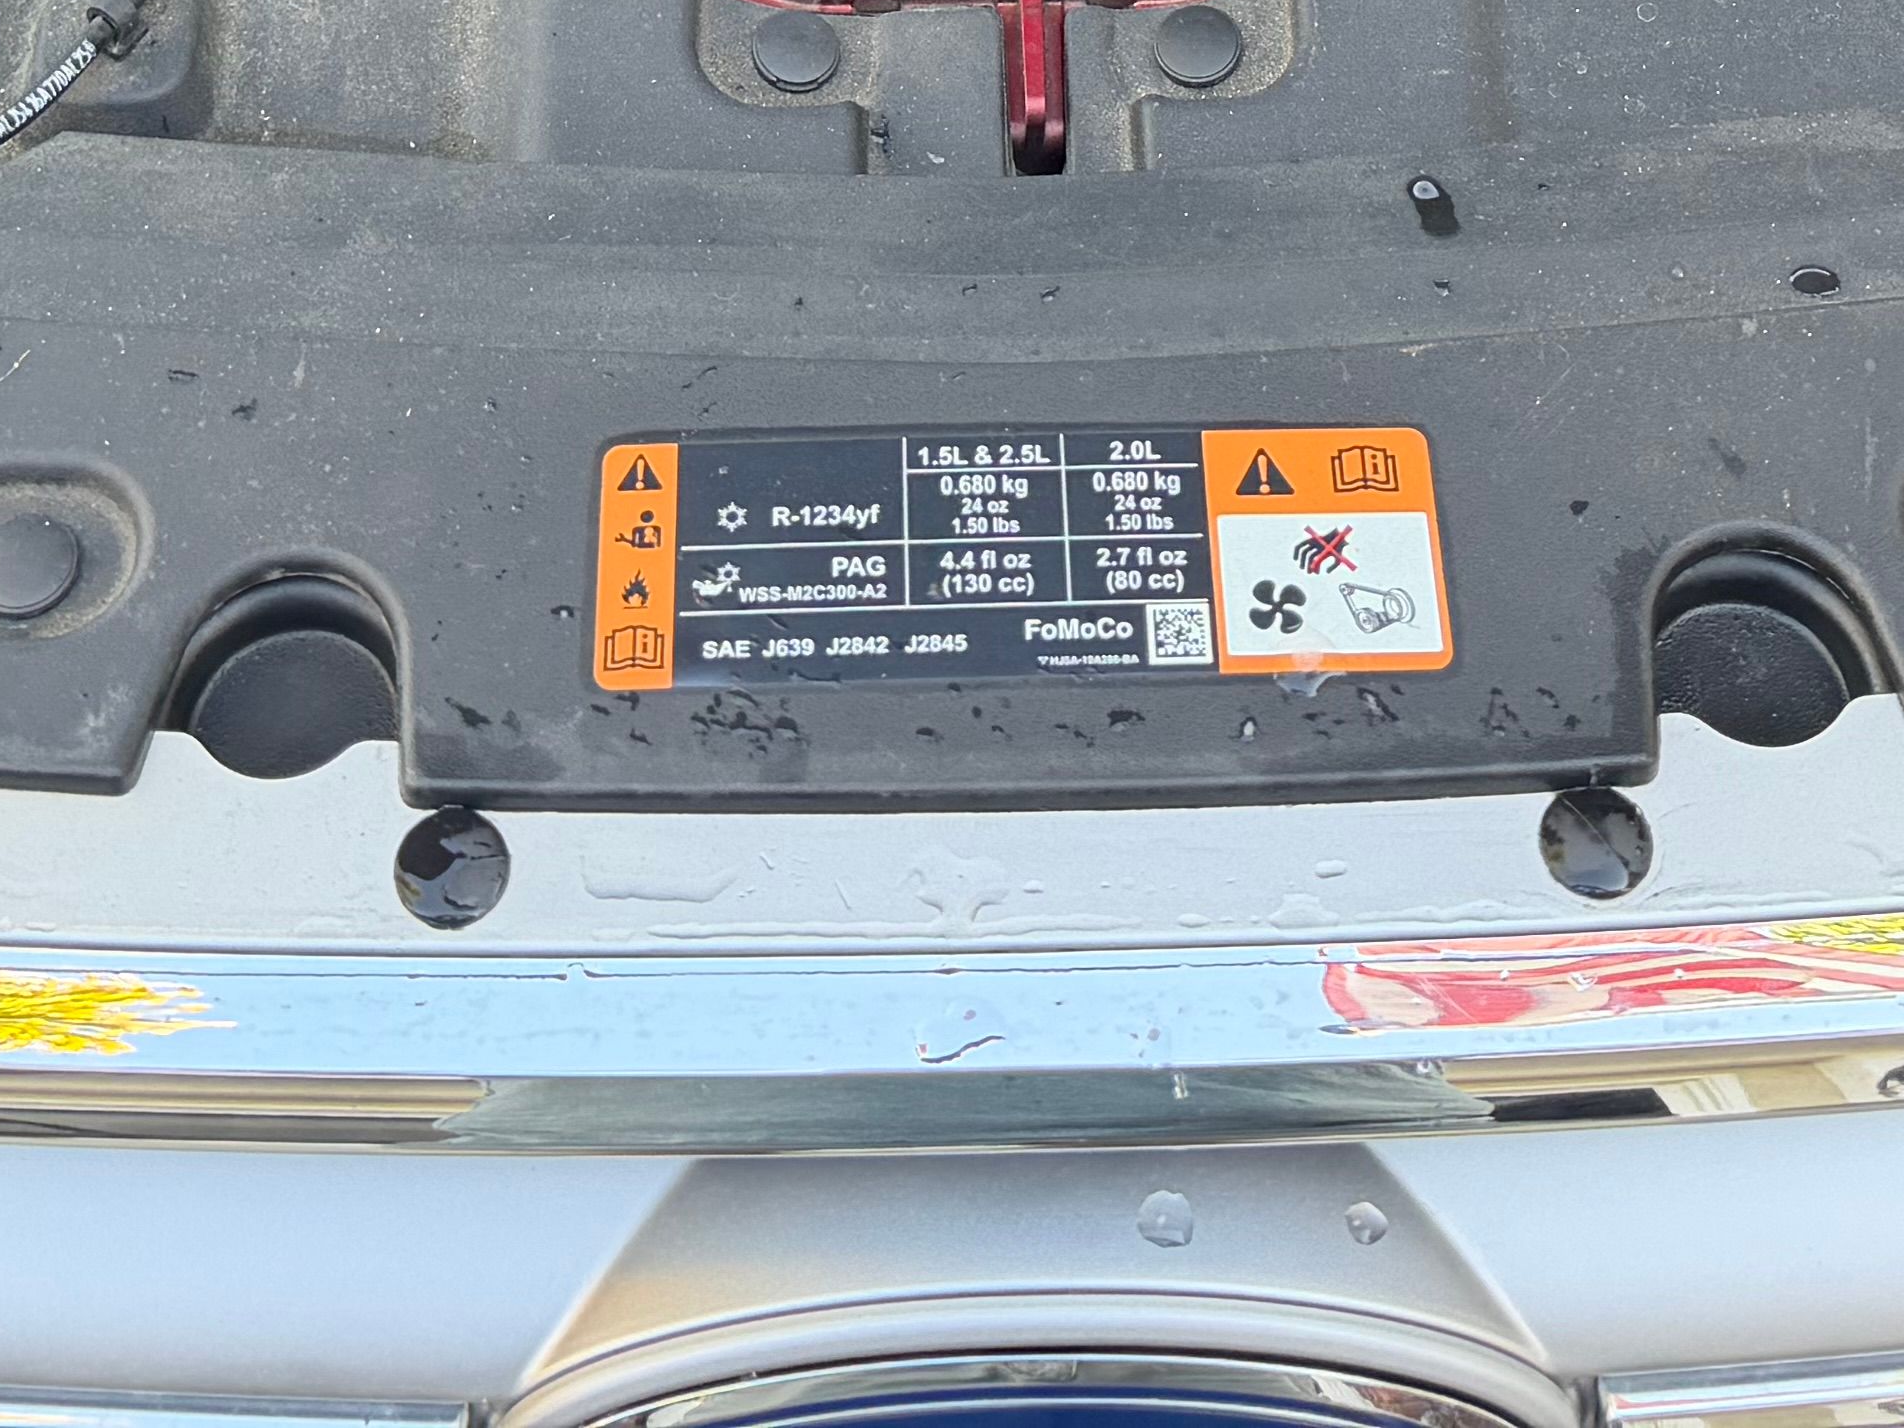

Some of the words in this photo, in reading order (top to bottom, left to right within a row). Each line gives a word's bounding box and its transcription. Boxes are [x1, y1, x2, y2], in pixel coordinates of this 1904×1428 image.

[918, 445, 968, 466] 1.5L
[974, 445, 993, 465] &
[999, 444, 1050, 465] 2.5L
[1109, 440, 1161, 461] 2.0L
[940, 475, 996, 496] 0.680
[1002, 475, 1029, 499] kg
[1093, 471, 1147, 492] 0.680
[1154, 470, 1181, 495] kg
[961, 498, 983, 515] 24
[987, 500, 1009, 514] oz
[1114, 494, 1136, 511] 24
[1140, 496, 1162, 510] oz
[771, 503, 881, 529] R-1234yf
[952, 517, 989, 534] 1.50
[993, 516, 1020, 533] lbs
[1105, 514, 1142, 531] 1.50
[1146, 513, 1174, 530] lbs
[831, 555, 886, 578] PAG
[940, 550, 975, 570] 4.4
[981, 550, 997, 569] fl
[1003, 553, 1032, 569] oz
[1096, 547, 1131, 568] 2.7
[1137, 547, 1152, 566] fl
[1159, 550, 1188, 565] oz
[942, 573, 992, 598] (130
[998, 572, 1034, 596] cc)
[1106, 570, 1142, 594] (80
[1148, 569, 1184, 593] cc)
[739, 583, 887, 603] WSS-M2C300-A2
[1024, 617, 1134, 641] FoMoCo
[702, 640, 751, 658] SAE
[762, 638, 816, 657] J639
[825, 636, 889, 655] J2842
[904, 634, 968, 654] J2845
